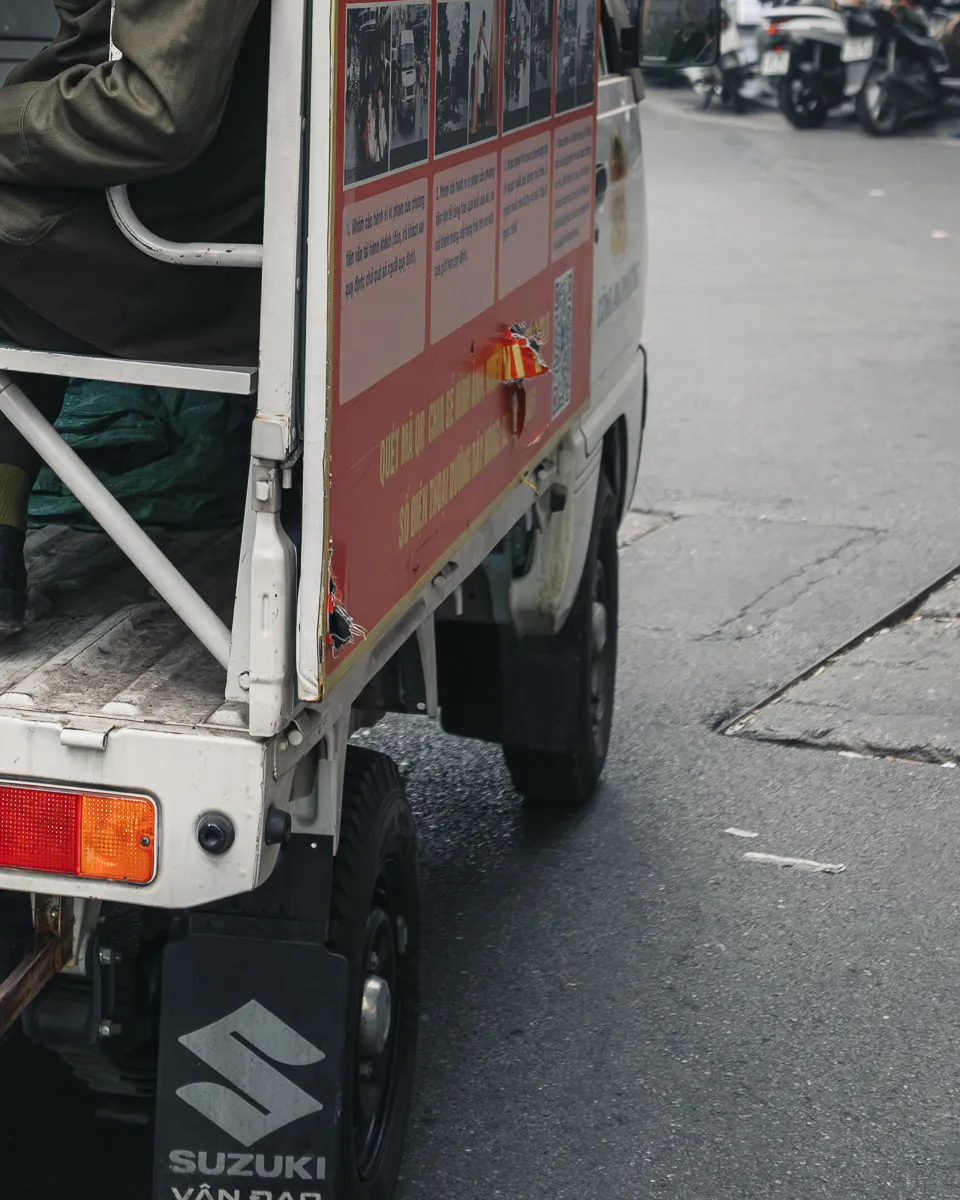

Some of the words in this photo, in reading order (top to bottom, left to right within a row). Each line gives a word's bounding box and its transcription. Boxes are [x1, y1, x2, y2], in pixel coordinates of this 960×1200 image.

[379, 422, 400, 487] QUÉT
[400, 411, 413, 467] MÃ
[398, 486, 410, 549] SỐ
[410, 480, 428, 541] ĐIỆN
[168, 1149, 327, 1180] SUZUKI
